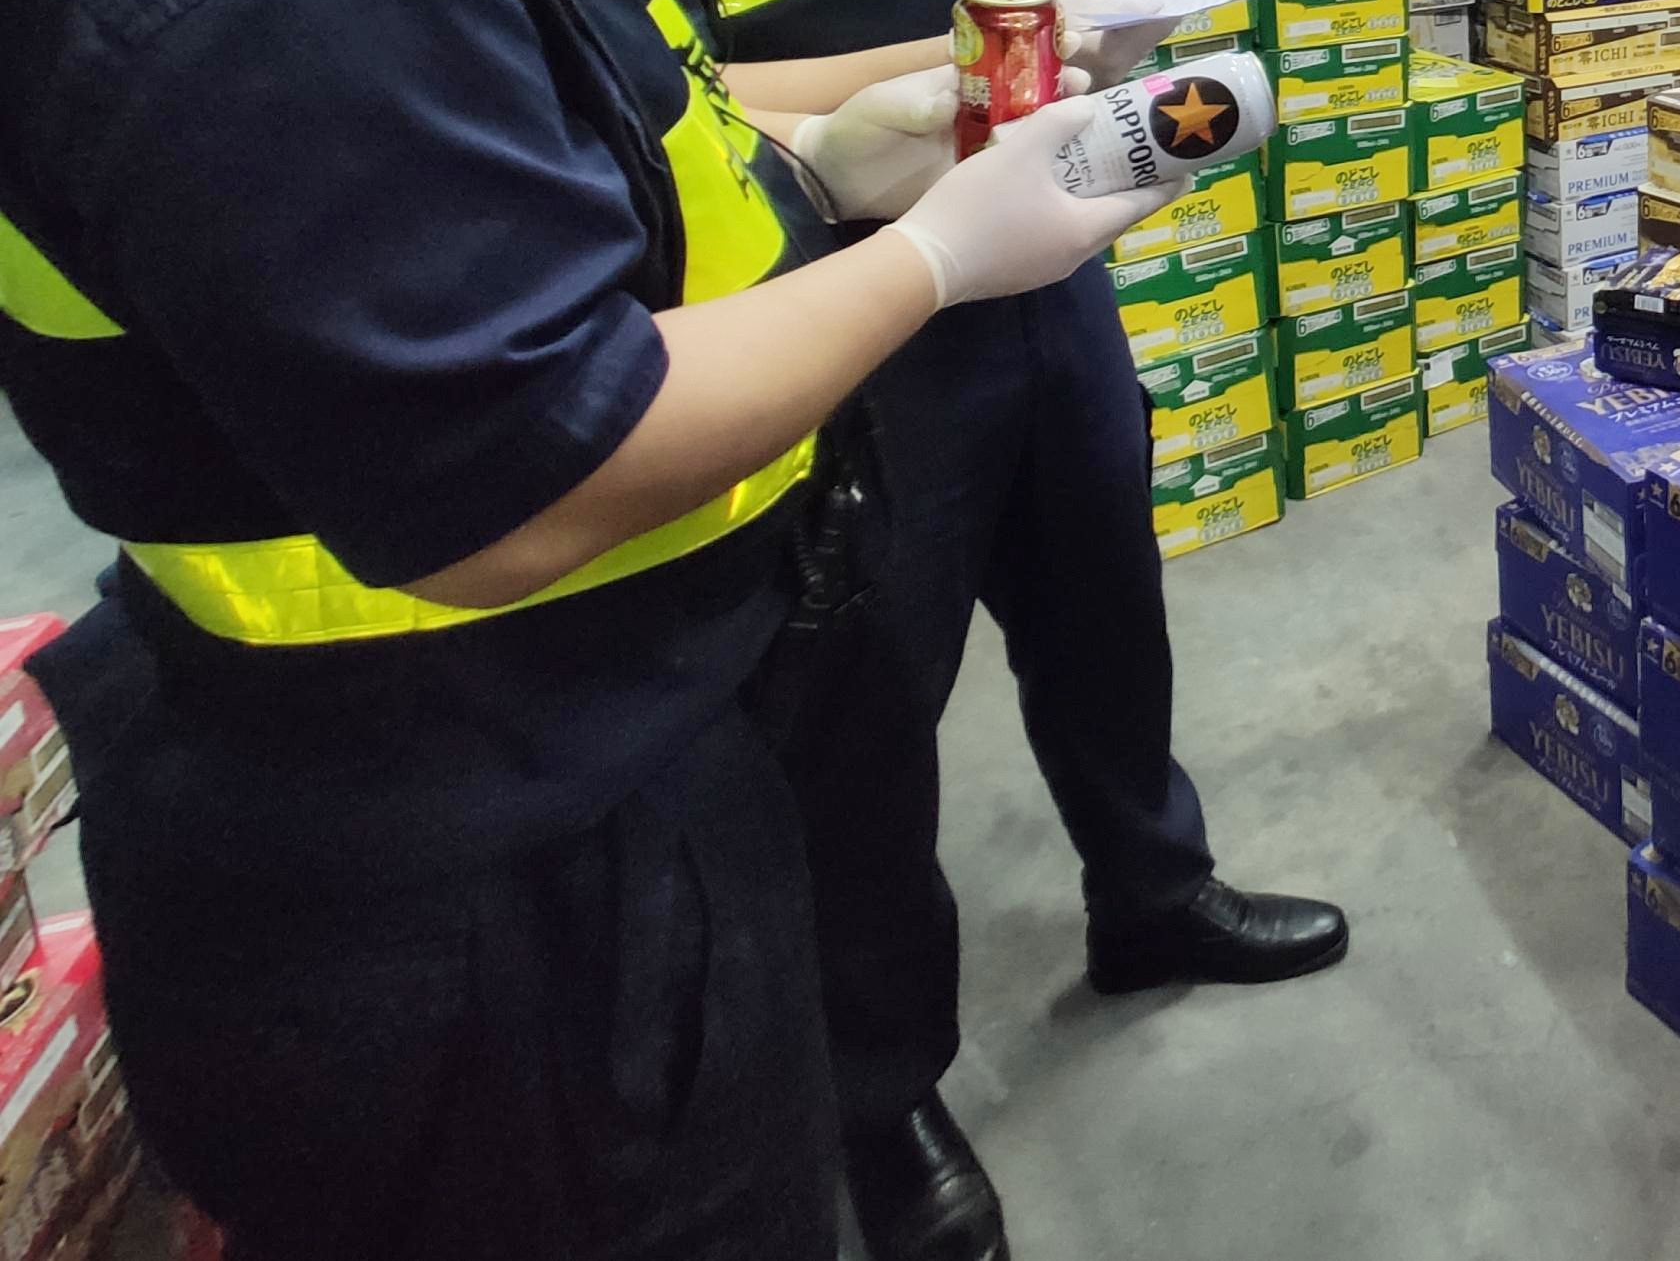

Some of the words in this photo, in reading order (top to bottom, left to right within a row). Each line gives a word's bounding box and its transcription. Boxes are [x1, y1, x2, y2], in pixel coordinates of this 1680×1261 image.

[1335, 165, 1380, 184] のどこし
[1568, 172, 1629, 192] PREMIUM
[1171, 199, 1221, 221] のどこし
[1568, 233, 1627, 256] PREMIUM
[1331, 260, 1375, 280] のどこし
[1174, 299, 1224, 320] のどこし
[1342, 346, 1385, 369] のどこし
[1188, 403, 1238, 428] のどこし
[1350, 434, 1393, 458] のどこし
[1196, 497, 1244, 522] のどこし
[1540, 603, 1626, 679] YEBISU
